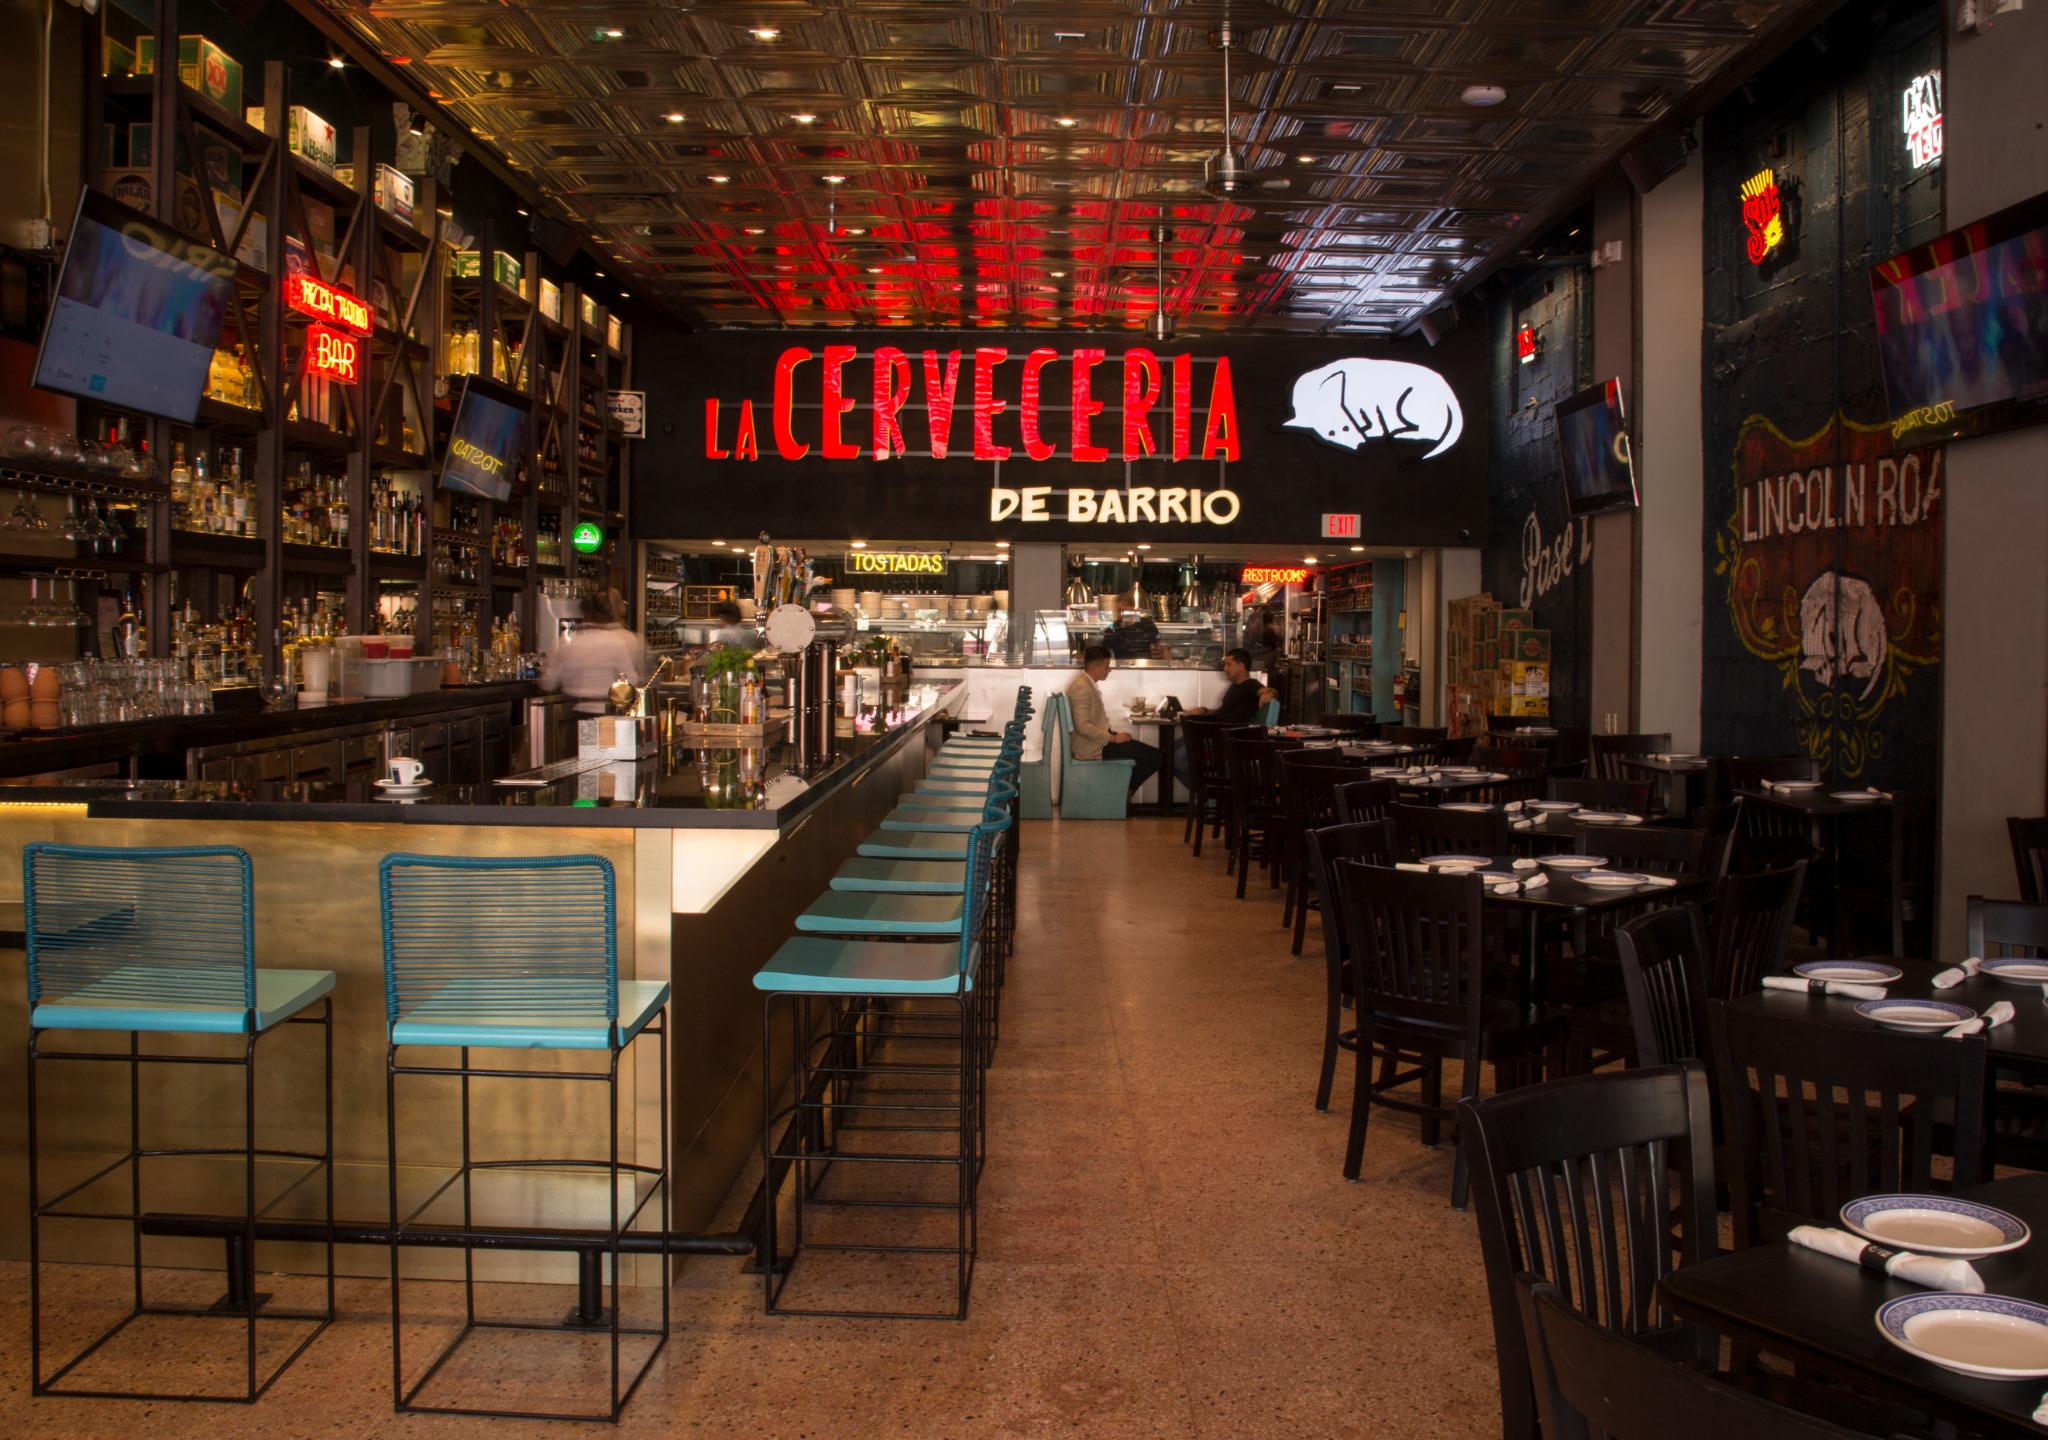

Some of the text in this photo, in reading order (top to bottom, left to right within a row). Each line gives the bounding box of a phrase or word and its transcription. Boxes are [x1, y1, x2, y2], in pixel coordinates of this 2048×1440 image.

[317, 332, 355, 378] BAR
[705, 345, 1241, 463] LA CERVECERIA
[990, 486, 1241, 525] DE BARRIO
[1742, 463, 1866, 543] LINCOLN
[1328, 514, 1356, 536] EXIT
[851, 552, 943, 572] TOSTADAS
[1243, 568, 1307, 583] RESTROOMS
